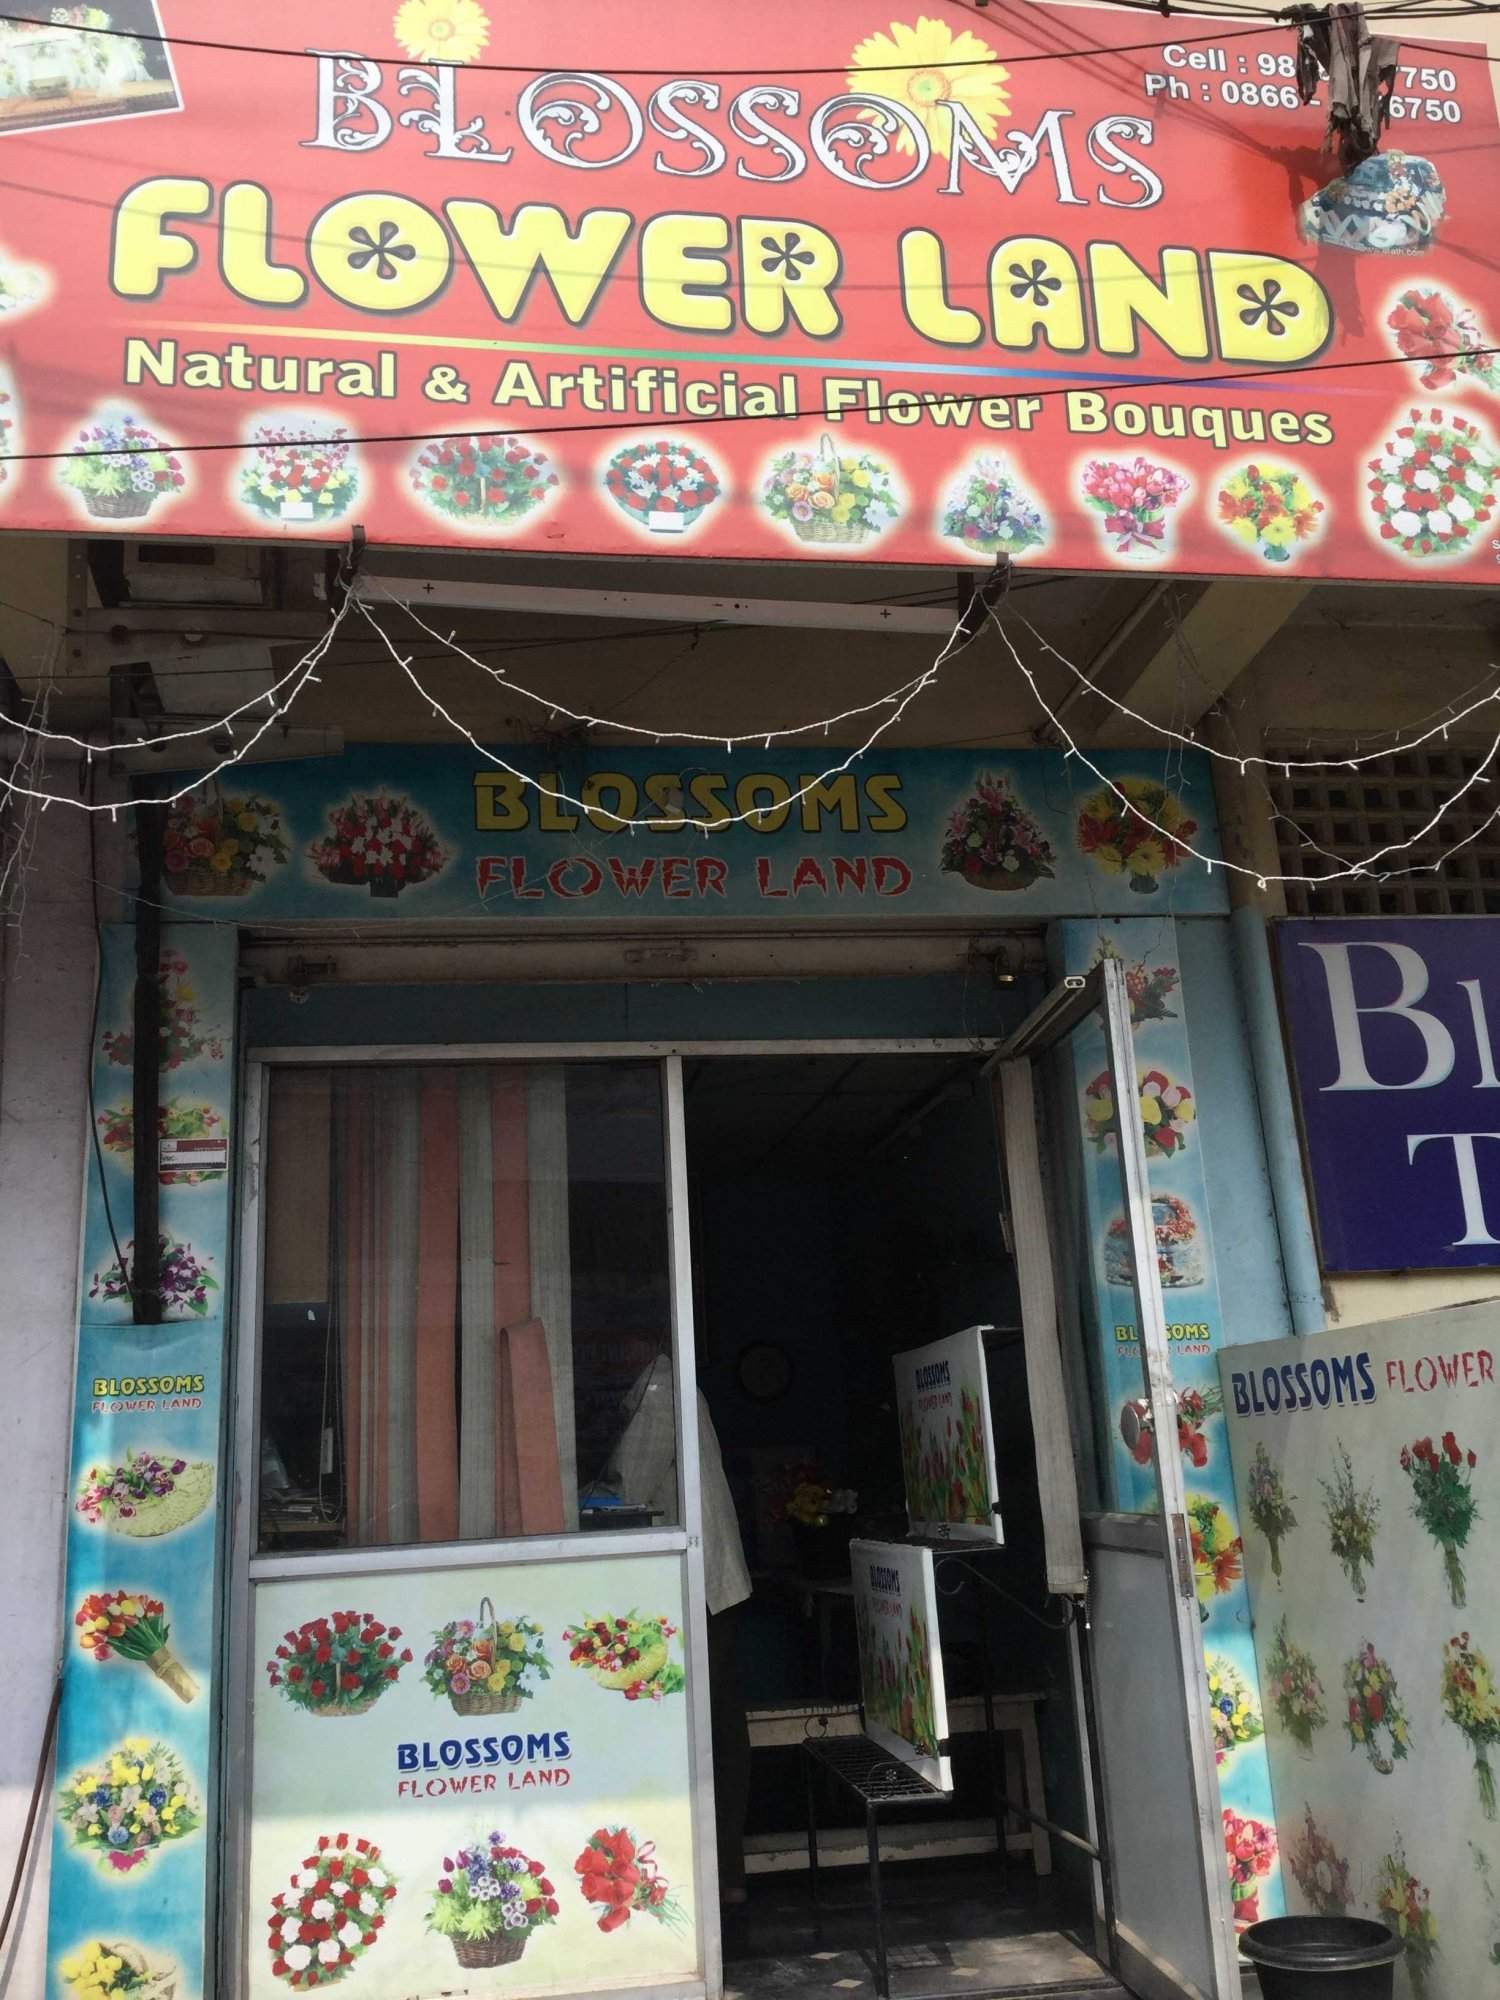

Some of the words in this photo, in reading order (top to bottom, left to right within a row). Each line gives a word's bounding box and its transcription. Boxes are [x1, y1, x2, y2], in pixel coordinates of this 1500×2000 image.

[1163, 45, 1227, 72] Cell
[1144, 74, 1190, 99] Ph
[1221, 81, 1300, 109] 0866
[1380, 95, 1462, 123] 6750
[300, 48, 1165, 209] BLOSSOMS
[110, 176, 843, 338] FLOWER
[898, 227, 1334, 365] LAND
[125, 338, 398, 399] Natural
[424, 363, 470, 404] &
[493, 360, 798, 421] Artificial
[824, 378, 1043, 432] Flower
[1066, 390, 1335, 450] Bouques
[472, 771, 909, 834] BLOSSOMS
[475, 855, 730, 899] FLOWER
[756, 855, 913, 899] LAND
[1115, 1323, 1210, 1341] BLSOMS
[1177, 1342, 1211, 1355] LAND
[93, 1375, 205, 1397] BLOSSOMS
[1232, 1352, 1377, 1417] BLOSSOMS
[1385, 1350, 1495, 1393] FLOWER
[91, 1399, 156, 1414] FLOWER
[162, 1397, 203, 1411] LAND
[397, 1731, 572, 1773] BLOSSOMS
[398, 1774, 497, 1798] FLOWER
[507, 1768, 571, 1791] LAND
